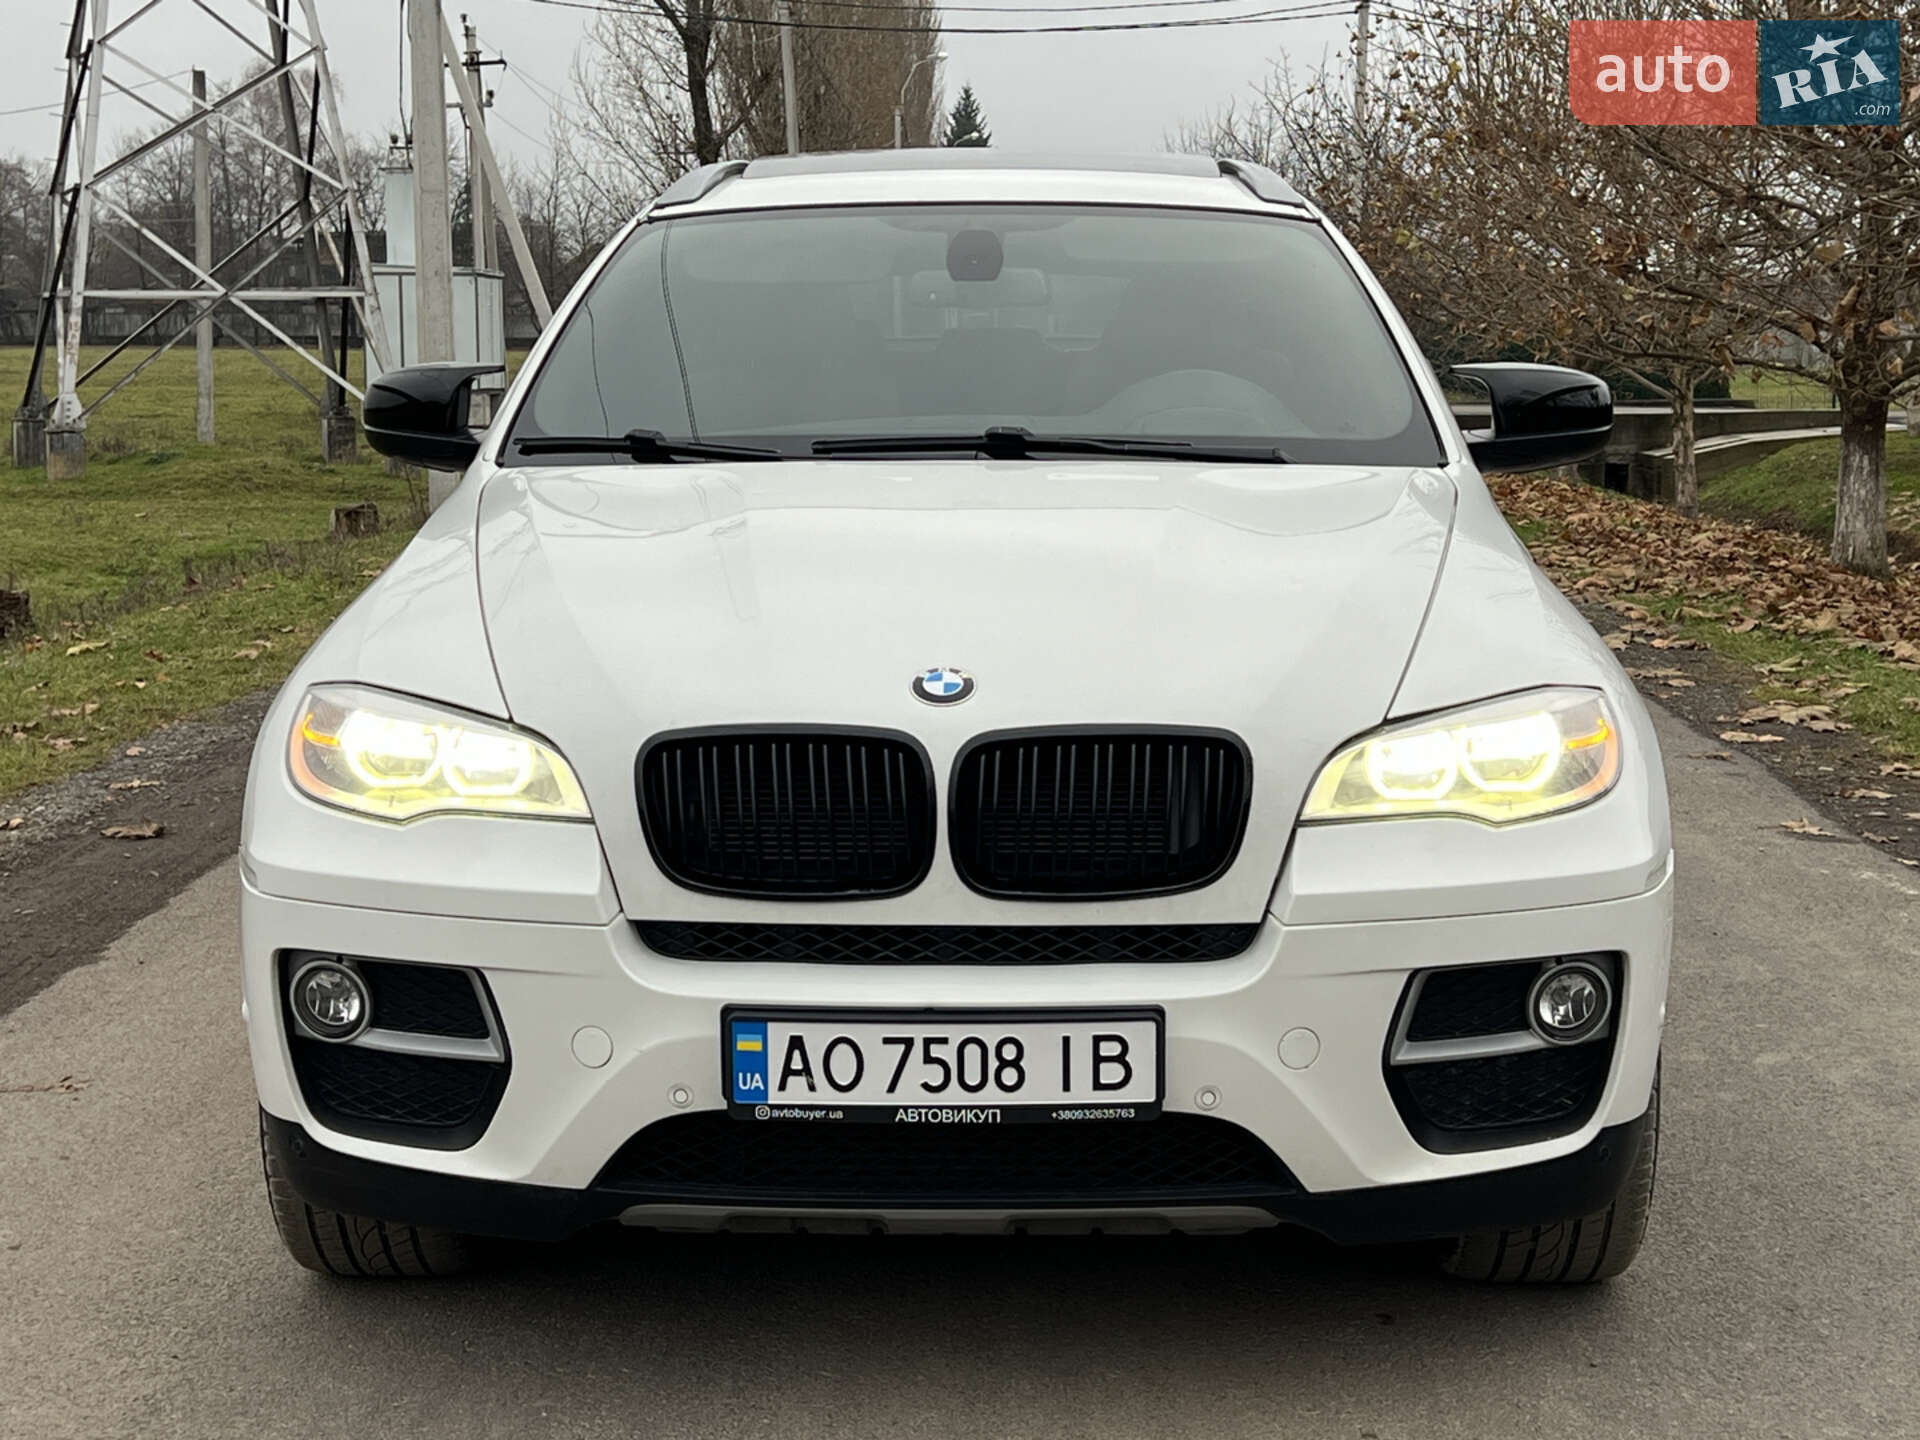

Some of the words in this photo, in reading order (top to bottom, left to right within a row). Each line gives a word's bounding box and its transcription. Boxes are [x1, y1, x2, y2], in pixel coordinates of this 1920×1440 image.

[777, 1034, 864, 1093] AO
[882, 1036, 1026, 1094] 7508
[1061, 1034, 1133, 1093] IB
[738, 1072, 765, 1091] UA
[771, 1107, 844, 1121] avtobuyer.ua
[895, 1108, 1001, 1124] АВТОВИКУП
